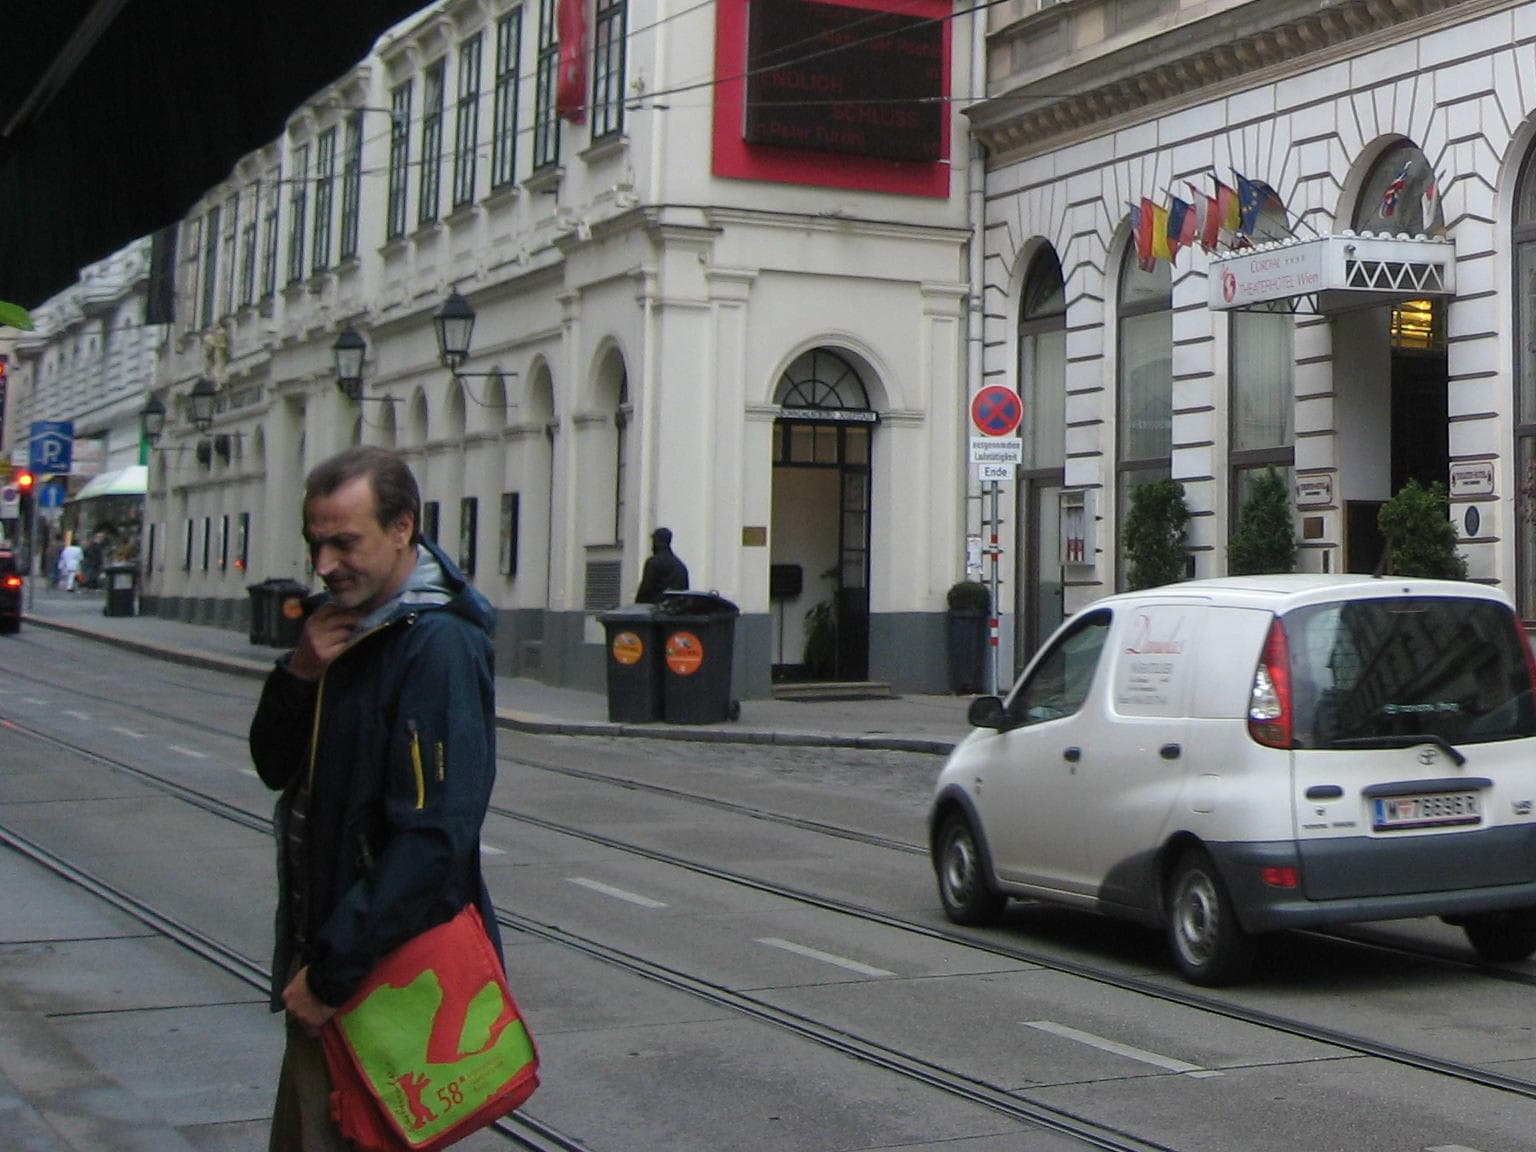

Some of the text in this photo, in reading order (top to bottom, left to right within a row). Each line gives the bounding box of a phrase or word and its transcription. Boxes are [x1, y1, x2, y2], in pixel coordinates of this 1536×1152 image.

[1297, 272, 1319, 286] Wien
[43, 440, 62, 465] P
[984, 467, 1008, 477] Ende
